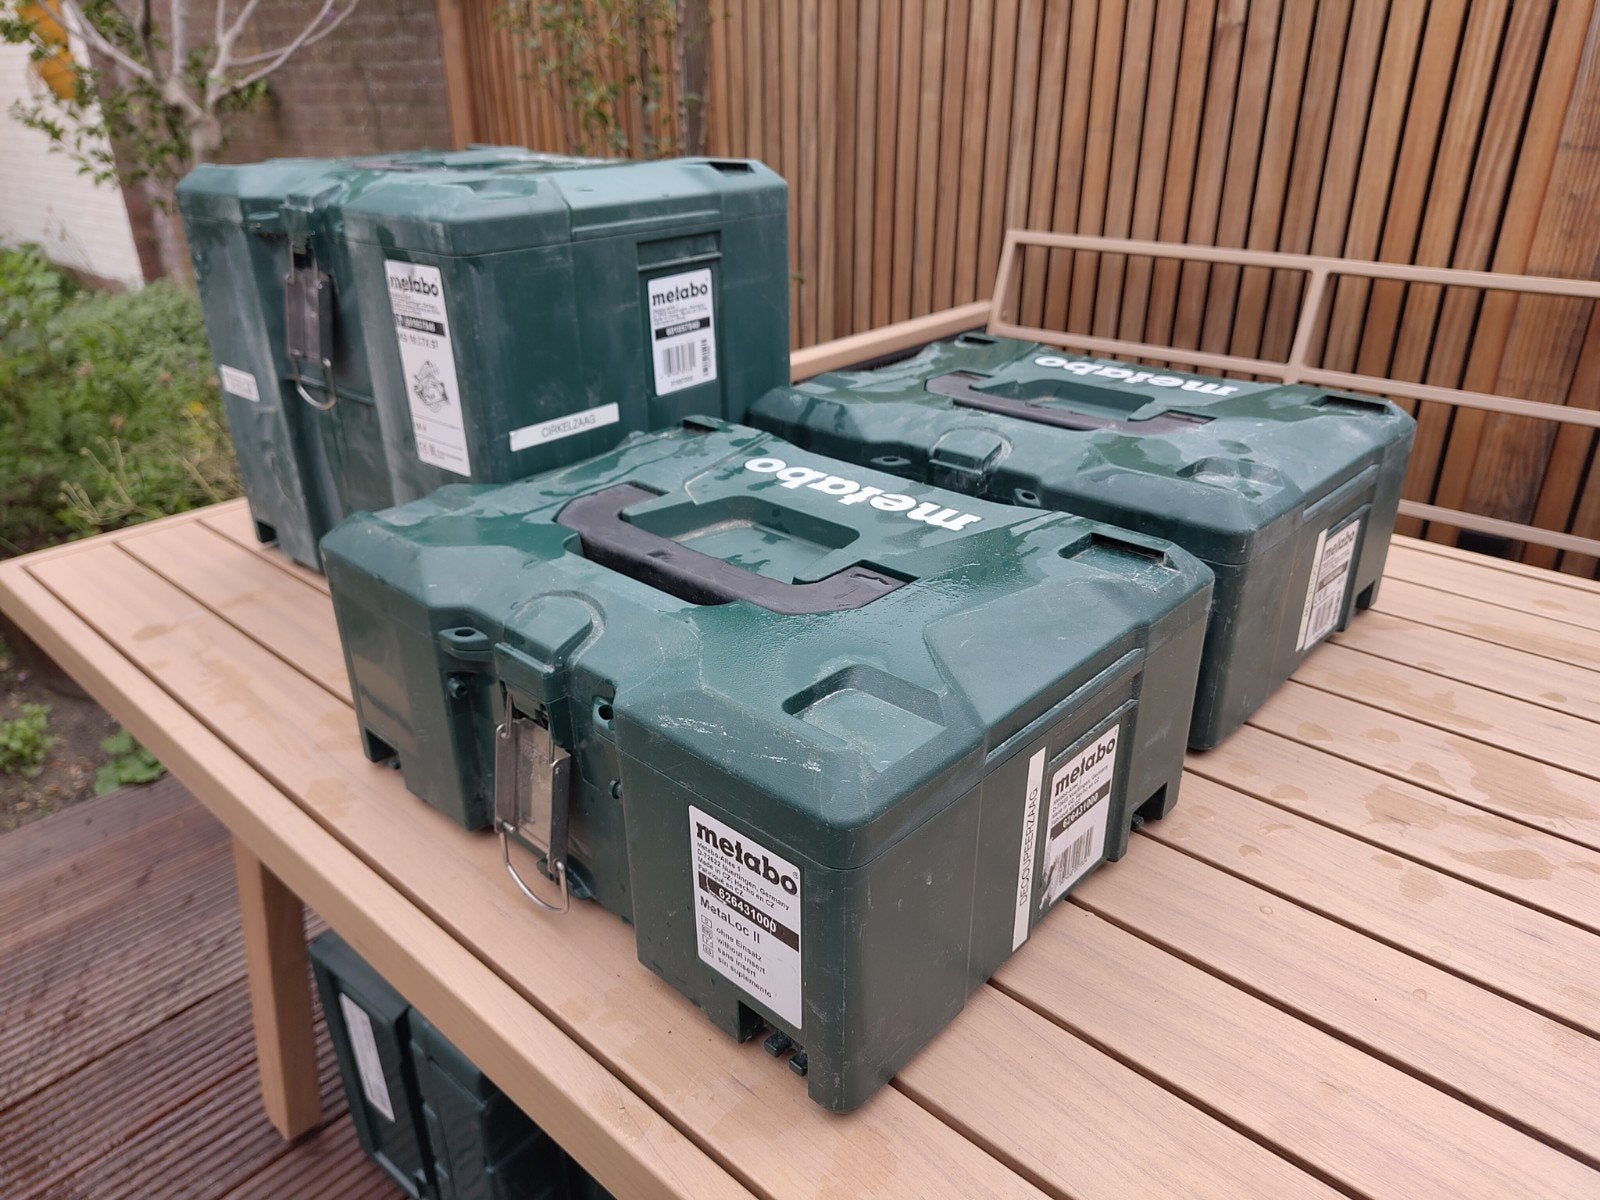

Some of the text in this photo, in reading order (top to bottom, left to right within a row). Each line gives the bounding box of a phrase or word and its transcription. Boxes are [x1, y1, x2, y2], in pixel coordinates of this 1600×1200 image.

[388, 274, 440, 297] metabo
[651, 281, 708, 306] metabo
[1034, 355, 1239, 396] metabo
[540, 414, 596, 438] CIRKELZAAG
[744, 457, 982, 532] metabo
[1054, 737, 1116, 797] metabo
[695, 821, 798, 896] metabo
[700, 895, 749, 937] MetaLoc
[718, 887, 776, 934] 626431000
